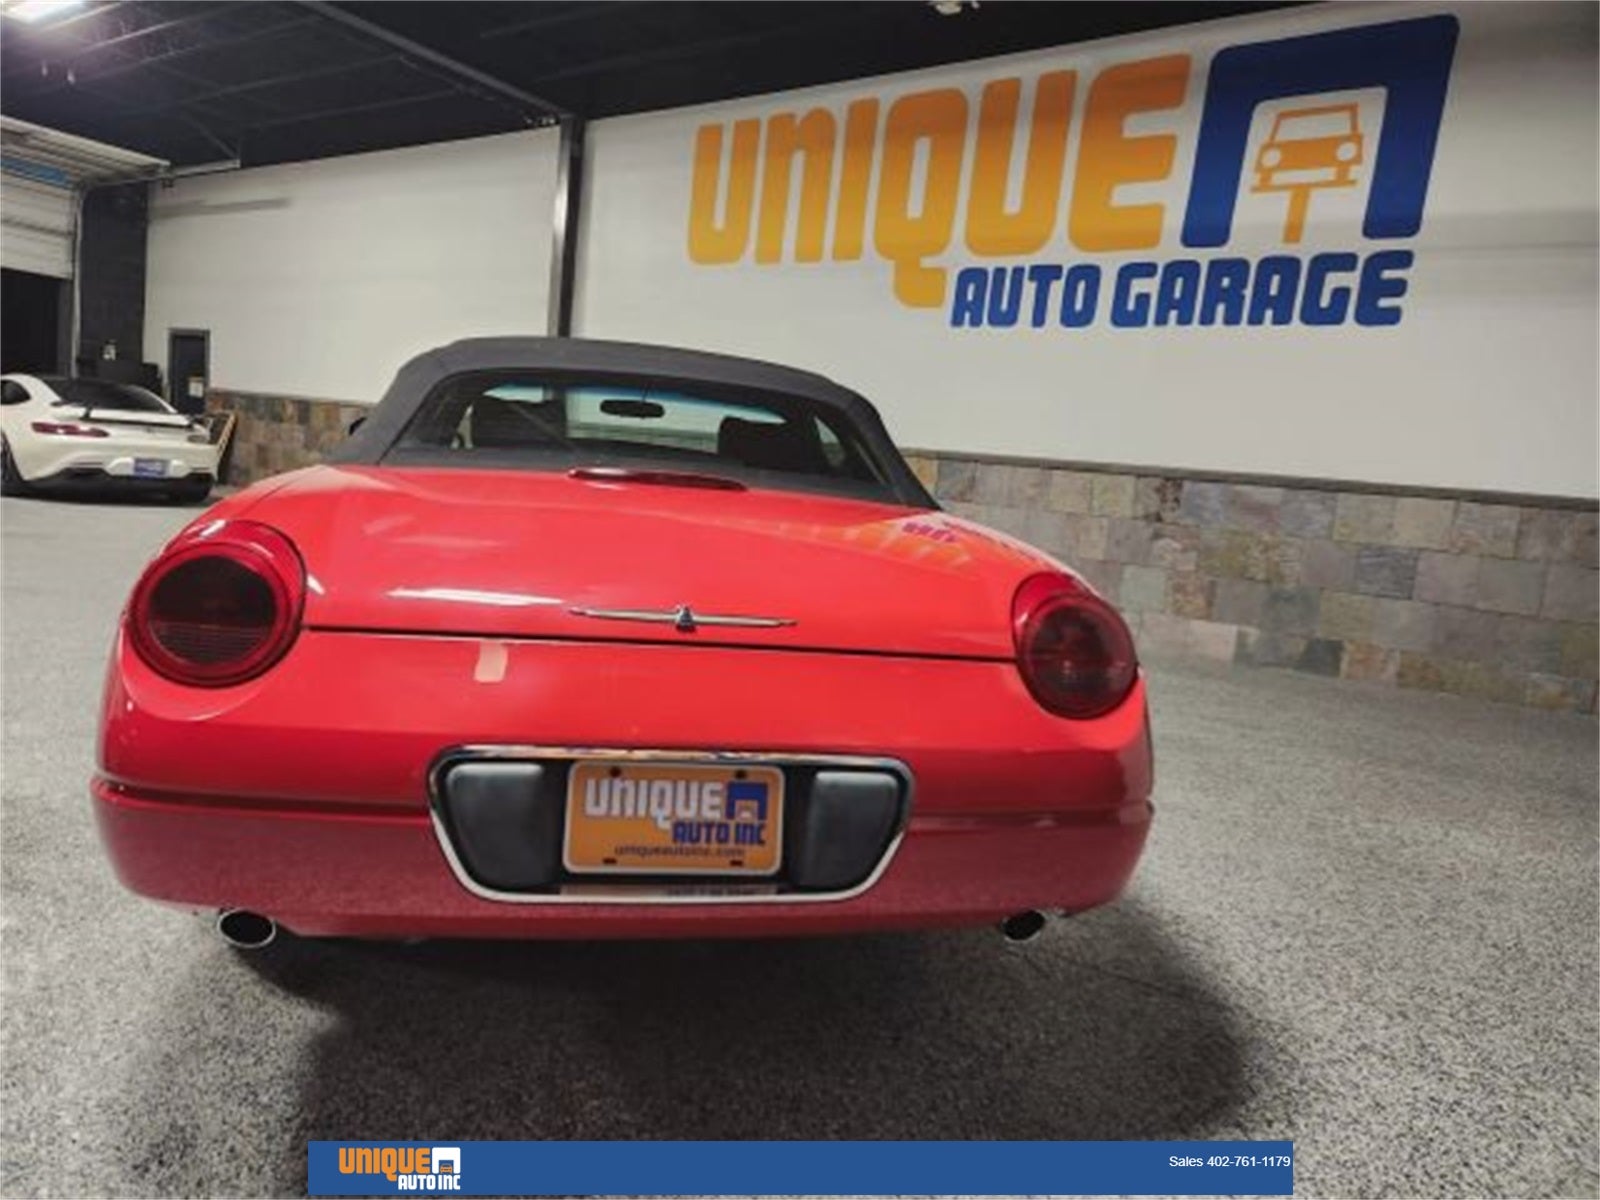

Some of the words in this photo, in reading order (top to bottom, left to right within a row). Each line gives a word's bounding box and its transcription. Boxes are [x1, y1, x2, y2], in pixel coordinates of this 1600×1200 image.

[687, 53, 1193, 308] UNIQUE
[951, 264, 1102, 328] AUTO
[1110, 250, 1414, 327] GARAGE
[584, 777, 724, 830] UNIQUE
[672, 821, 730, 844] AUTO
[734, 823, 766, 846] INC
